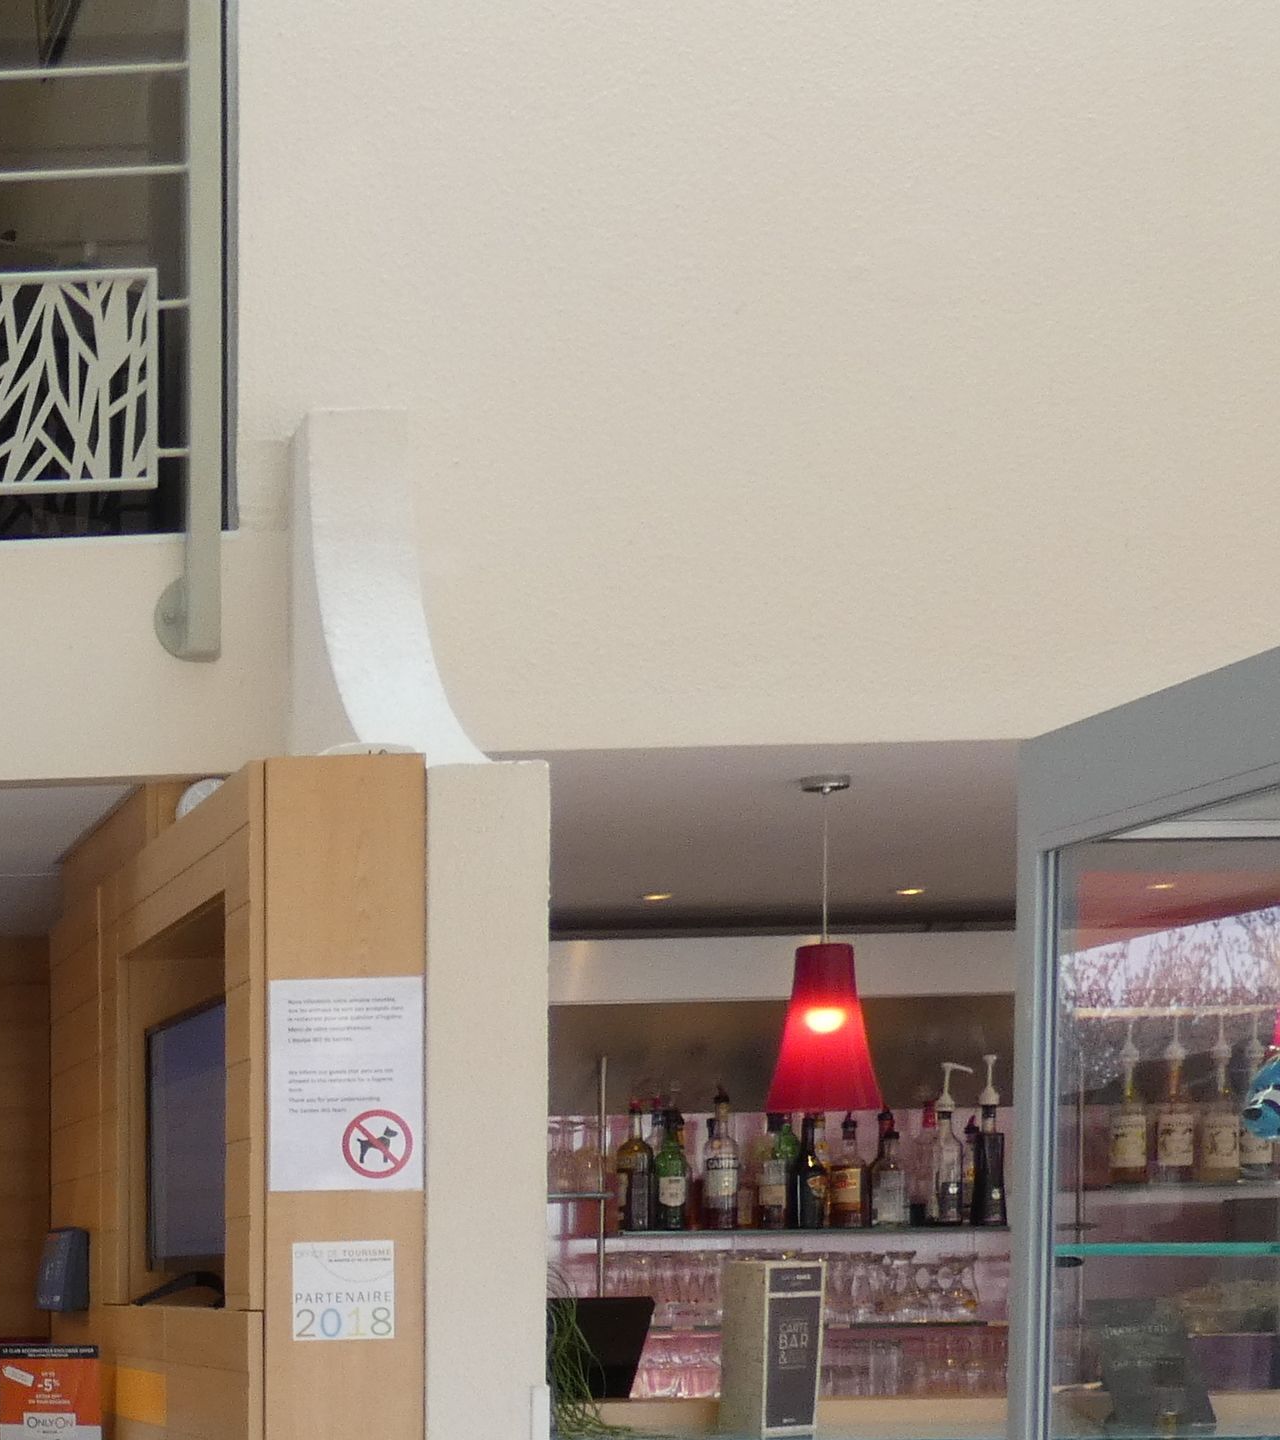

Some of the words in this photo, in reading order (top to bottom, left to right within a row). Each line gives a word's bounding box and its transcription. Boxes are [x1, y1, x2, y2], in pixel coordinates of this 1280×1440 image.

[342, 1248, 392, 1257] TOURISME
[295, 1290, 392, 1304] PARTENAIRE
[295, 1306, 392, 1338] 2018
[778, 1333, 808, 1350] BAR
